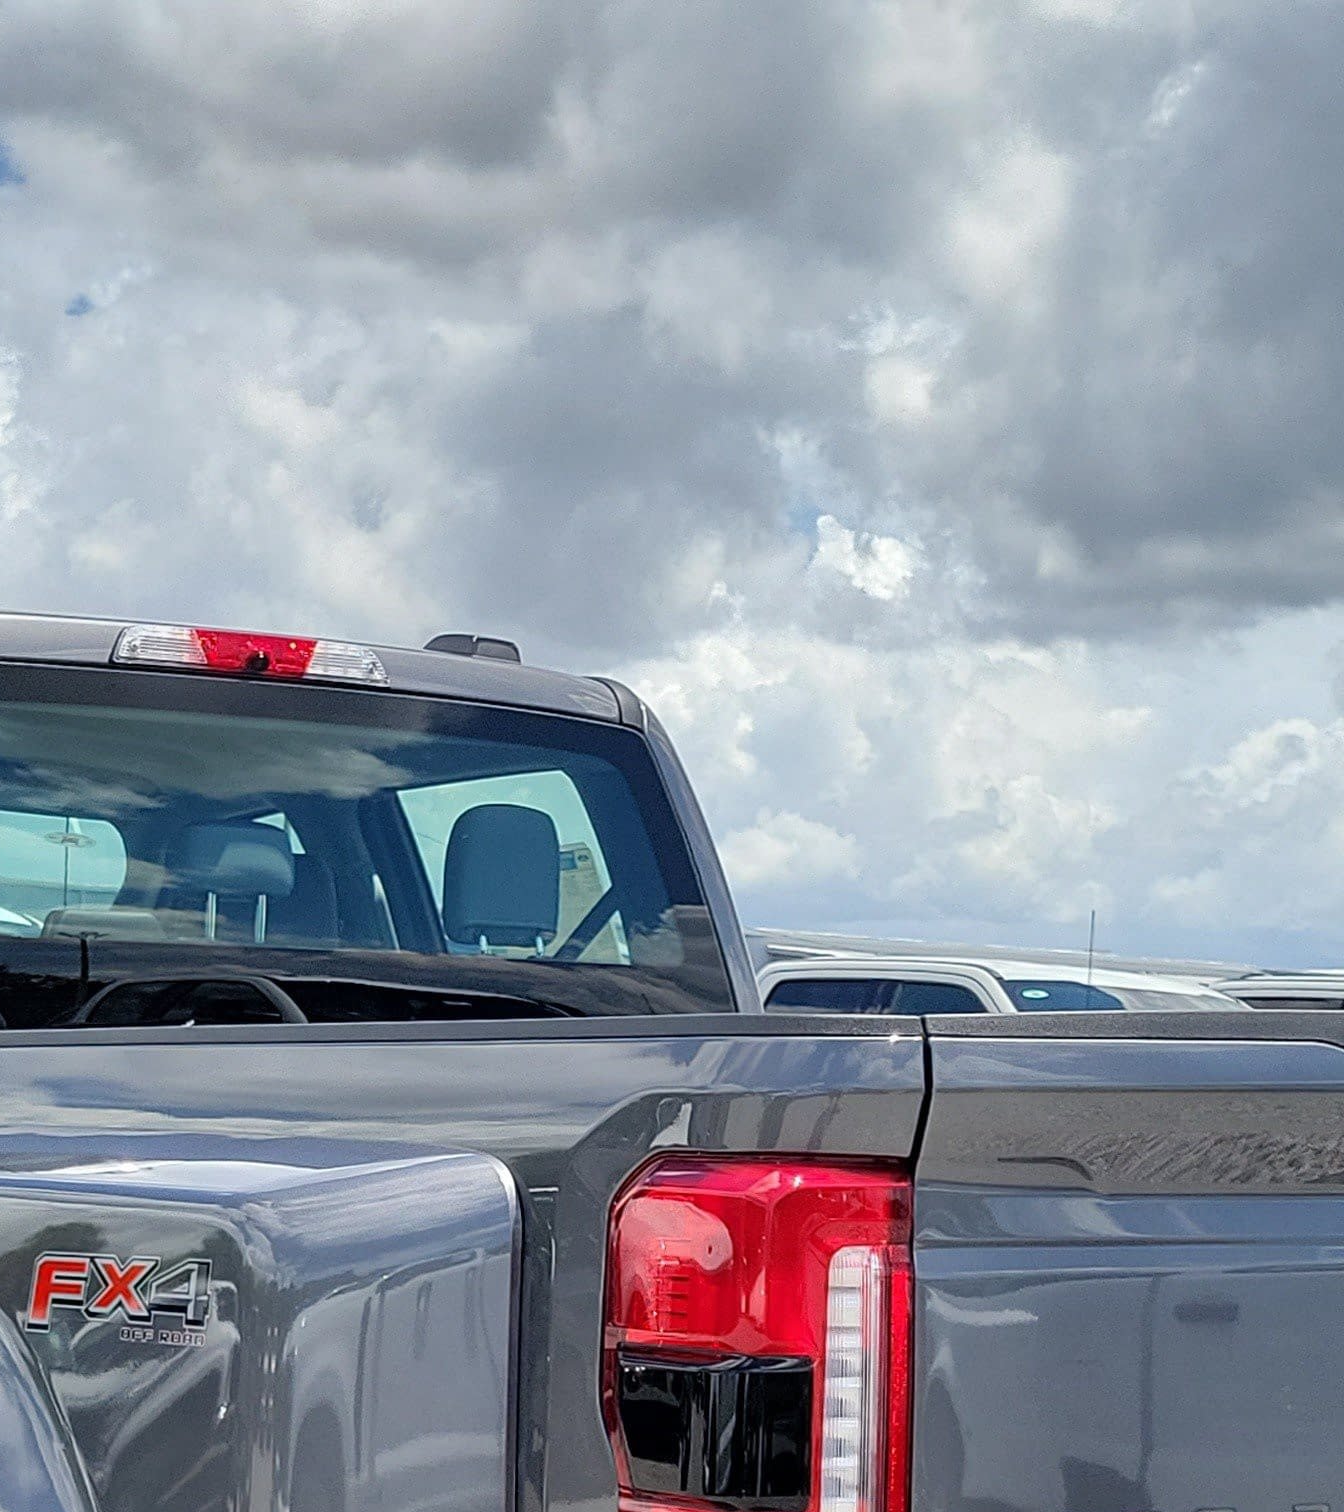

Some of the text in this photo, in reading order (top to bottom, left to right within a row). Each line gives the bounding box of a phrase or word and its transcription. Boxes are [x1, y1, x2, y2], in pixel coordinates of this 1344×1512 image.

[25, 1252, 213, 1332] FX4
[120, 1327, 206, 1346] OFF ROAD
